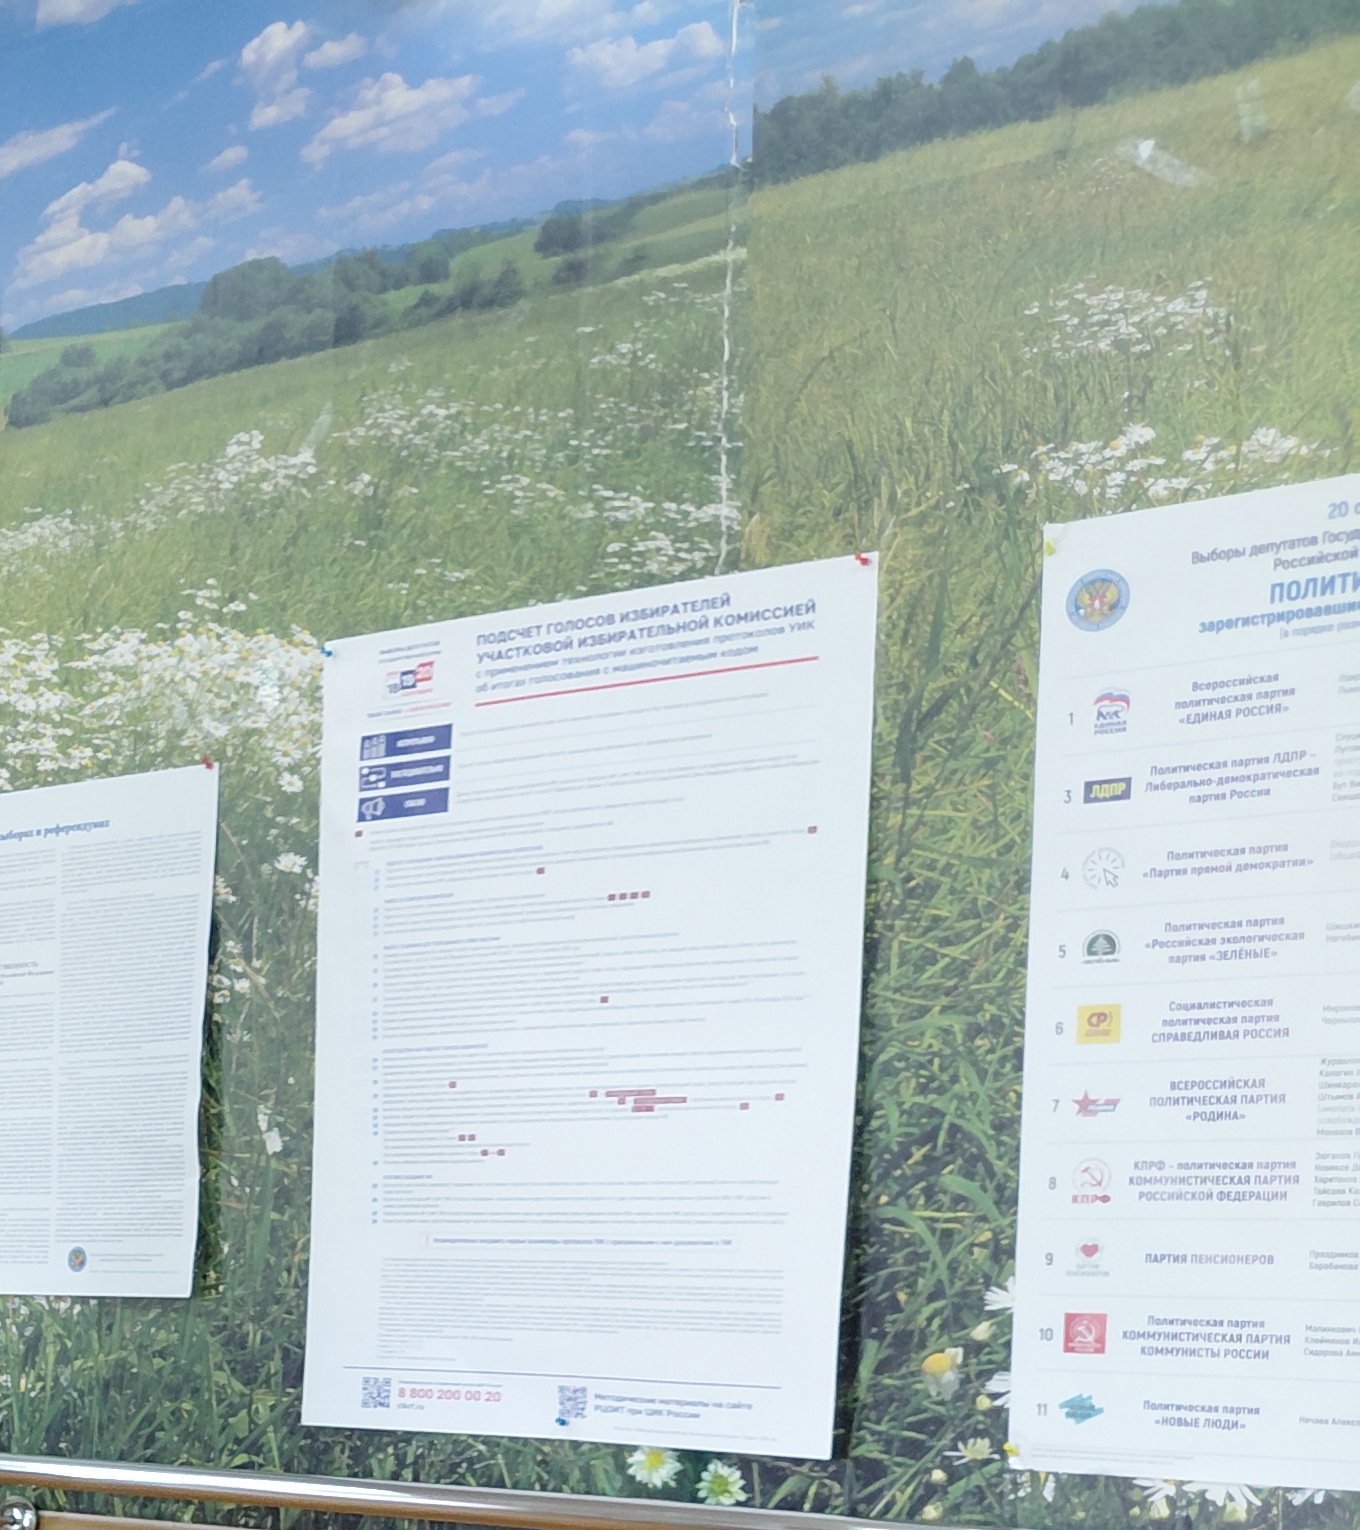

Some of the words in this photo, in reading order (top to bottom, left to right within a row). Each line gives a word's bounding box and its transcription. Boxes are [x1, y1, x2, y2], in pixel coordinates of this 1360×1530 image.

[1328, 501, 1349, 519] 20
[1191, 547, 1246, 565] Выборы
[1249, 535, 1319, 558] депутатов
[1323, 528, 1360, 545] Госуд
[1273, 545, 1359, 571] Российской
[476, 624, 543, 646] ПОДСЧЕТ
[546, 613, 616, 635] ГОЛОСОВ
[619, 591, 731, 623] ИЗБИРАТЕЛЕЙ
[1199, 600, 1360, 634] зарегистрировавши
[476, 635, 574, 664] УЧАСТКОВОЙ
[578, 614, 710, 648] ИЗБИРАТЕЛЬНОЙ
[713, 598, 817, 628] КОМИССИЕЙ
[1191, 673, 1279, 692] Всероссийская
[1174, 692, 1253, 710] политическая
[1256, 687, 1296, 702] партия
[1068, 712, 1074, 726] 1
[1179, 709, 1232, 725] «ЕДИНАЯ
[1235, 703, 1290, 719] РОССИЯ»
[1150, 759, 1228, 777] Политическая
[1231, 754, 1269, 769] партия
[1272, 749, 1307, 764] ЛДПР
[1144, 766, 1320, 793] Либерально-демократическая
[1064, 789, 1072, 804] 3
[1089, 781, 1127, 799] ЛДПР
[1188, 790, 1226, 805] партия
[1229, 787, 1271, 801] России
[1167, 846, 1246, 862] Политическая
[1249, 843, 1289, 857] партия
[1060, 867, 1070, 881] 4
[1142, 864, 1188, 879] «Партия
[1190, 860, 1233, 877] прямой
[1235, 856, 1314, 874] демократии»
[1164, 918, 1243, 933] Политическая
[1245, 915, 1285, 930] партия
[1144, 934, 1217, 950] «Российская
[1219, 929, 1305, 947] экологическая
[1058, 944, 1066, 959] 5
[1168, 951, 1206, 965] партия
[1168, 997, 1273, 1012] Социалистическая
[1161, 1014, 1238, 1028] политическая
[1241, 1012, 1280, 1026] партия
[1055, 1021, 1064, 1036] 6
[1151, 1028, 1240, 1043] СПРАВЕДЛИВАЯ
[1242, 1027, 1290, 1040] РОССИЯ
[1169, 1076, 1266, 1091] ВСЕРОССИЙСКАЯ
[1051, 1098, 1060, 1113] 7
[1149, 1094, 1238, 1107] ПОЛИТИЧЕСКАЯ
[1240, 1093, 1286, 1105] ПАРТИЯ
[1185, 1111, 1246, 1123] «РОДИНА»
[1133, 1160, 1166, 1172] КПРФ
[1176, 1161, 1254, 1171] политическая
[1256, 1160, 1297, 1172] партия
[1048, 1176, 1057, 1191] 8
[1128, 1175, 1251, 1187] КОММУНИСТИЧЕСКАЯ
[1253, 1174, 1300, 1186] ПАРТИЯ
[1138, 1187, 1213, 1202] РОССИЙСКОЙ
[1216, 1189, 1288, 1203] ФЕДЕРАЦИИ
[1044, 1252, 1054, 1266] 9
[1145, 1253, 1188, 1265] ПАРТИЯ
[1190, 1253, 1275, 1266] ПЕНСИОНЕРОВ
[1147, 1315, 1224, 1328] Политическая
[1227, 1319, 1265, 1330] партия
[1039, 1327, 1054, 1341] 10
[1122, 1330, 1243, 1344] КОММУНИСТИЧЕСКАЯ
[1245, 1333, 1291, 1346] ПАРТИЯ
[1140, 1345, 1221, 1359] КОММУНИСТЫ
[1223, 1348, 1270, 1360] РОССИИ
[398, 1387, 406, 1398] 8
[409, 1388, 434, 1399] 800
[437, 1389, 461, 1400] 200
[484, 1391, 502, 1402] 20
[1036, 1403, 1048, 1416] 11
[1143, 1400, 1220, 1415] Политическая
[1222, 1404, 1261, 1416] партия
[1154, 1416, 1200, 1429] «НОВЫЕ
[1202, 1418, 1246, 1430] ЛЮДИ»
